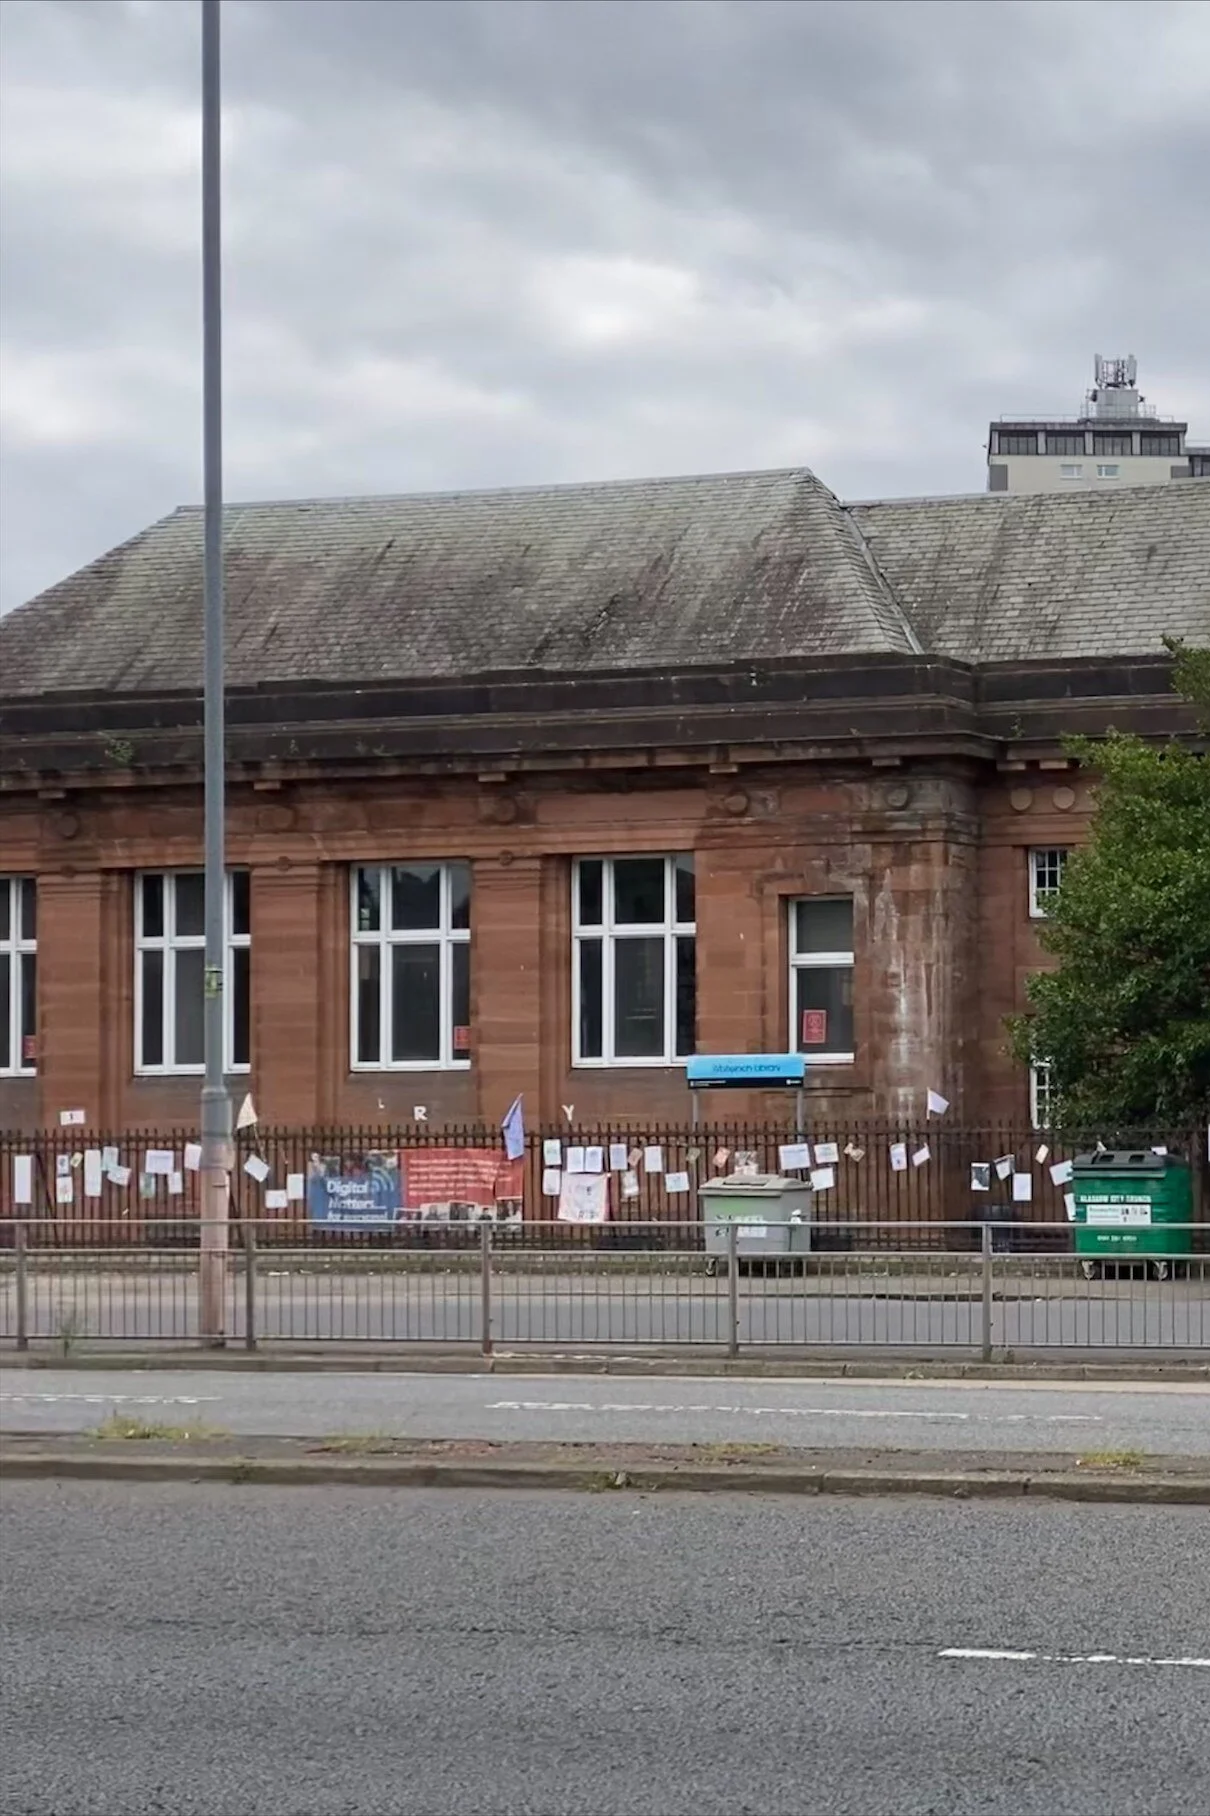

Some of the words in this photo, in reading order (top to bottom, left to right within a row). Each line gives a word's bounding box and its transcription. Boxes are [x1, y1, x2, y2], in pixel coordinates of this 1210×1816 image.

[413, 1105, 427, 1121] R
[561, 1104, 575, 1121] Y
[326, 1180, 369, 1197] Digital
